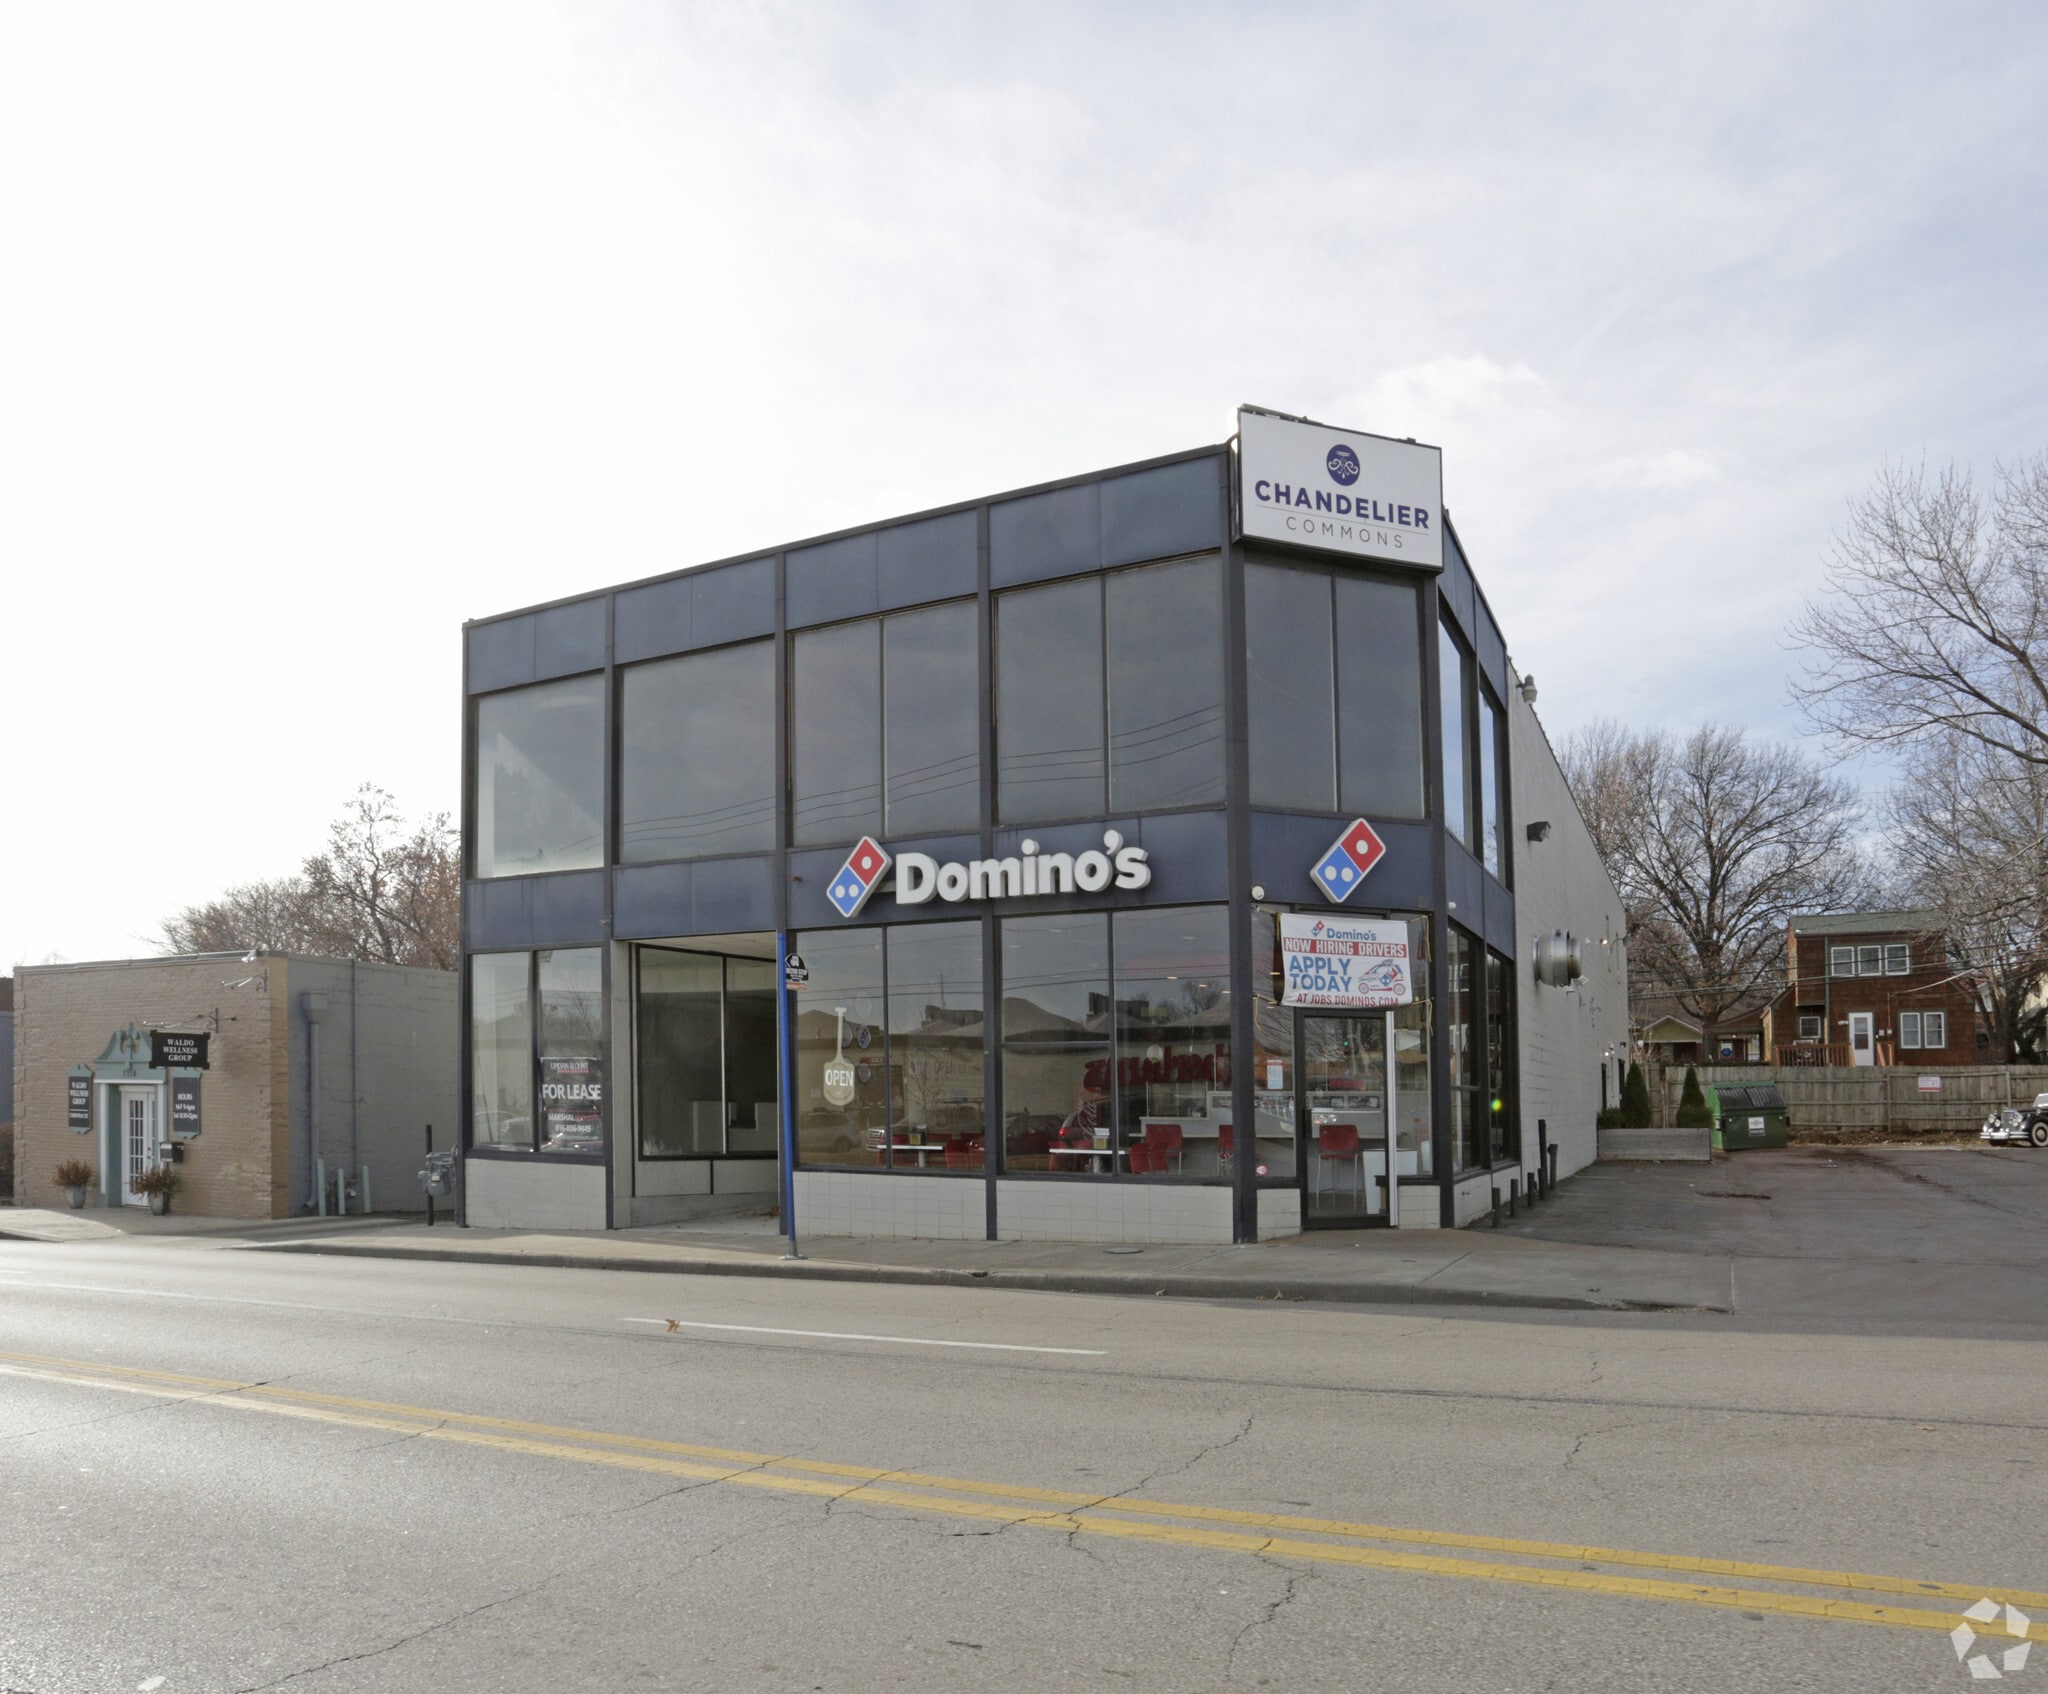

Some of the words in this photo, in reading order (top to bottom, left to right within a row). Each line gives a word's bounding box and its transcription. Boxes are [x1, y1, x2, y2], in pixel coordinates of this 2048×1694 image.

[1254, 480, 1430, 530] CHANDELIER
[1286, 516, 1404, 549] COMMONS
[895, 829, 1152, 905] Domino's
[1326, 928, 1377, 941] Domino's
[1284, 938, 1311, 953] NOW
[1316, 941, 1354, 955] HIRING
[1358, 943, 1405, 957] DRIVERS
[1289, 955, 1351, 975] APPLY
[1289, 973, 1352, 992] TODAY
[1296, 994, 1308, 1003] AT
[1310, 994, 1399, 1007] JOBS.DOMINOS.COM
[163, 1046, 199, 1054] WELLNESS
[167, 1038, 195, 1046] WALDO
[168, 1054, 193, 1062] GROUP
[825, 1069, 854, 1087] OPEN
[542, 1084, 566, 1099] FOR
[567, 1084, 602, 1100] LEASE
